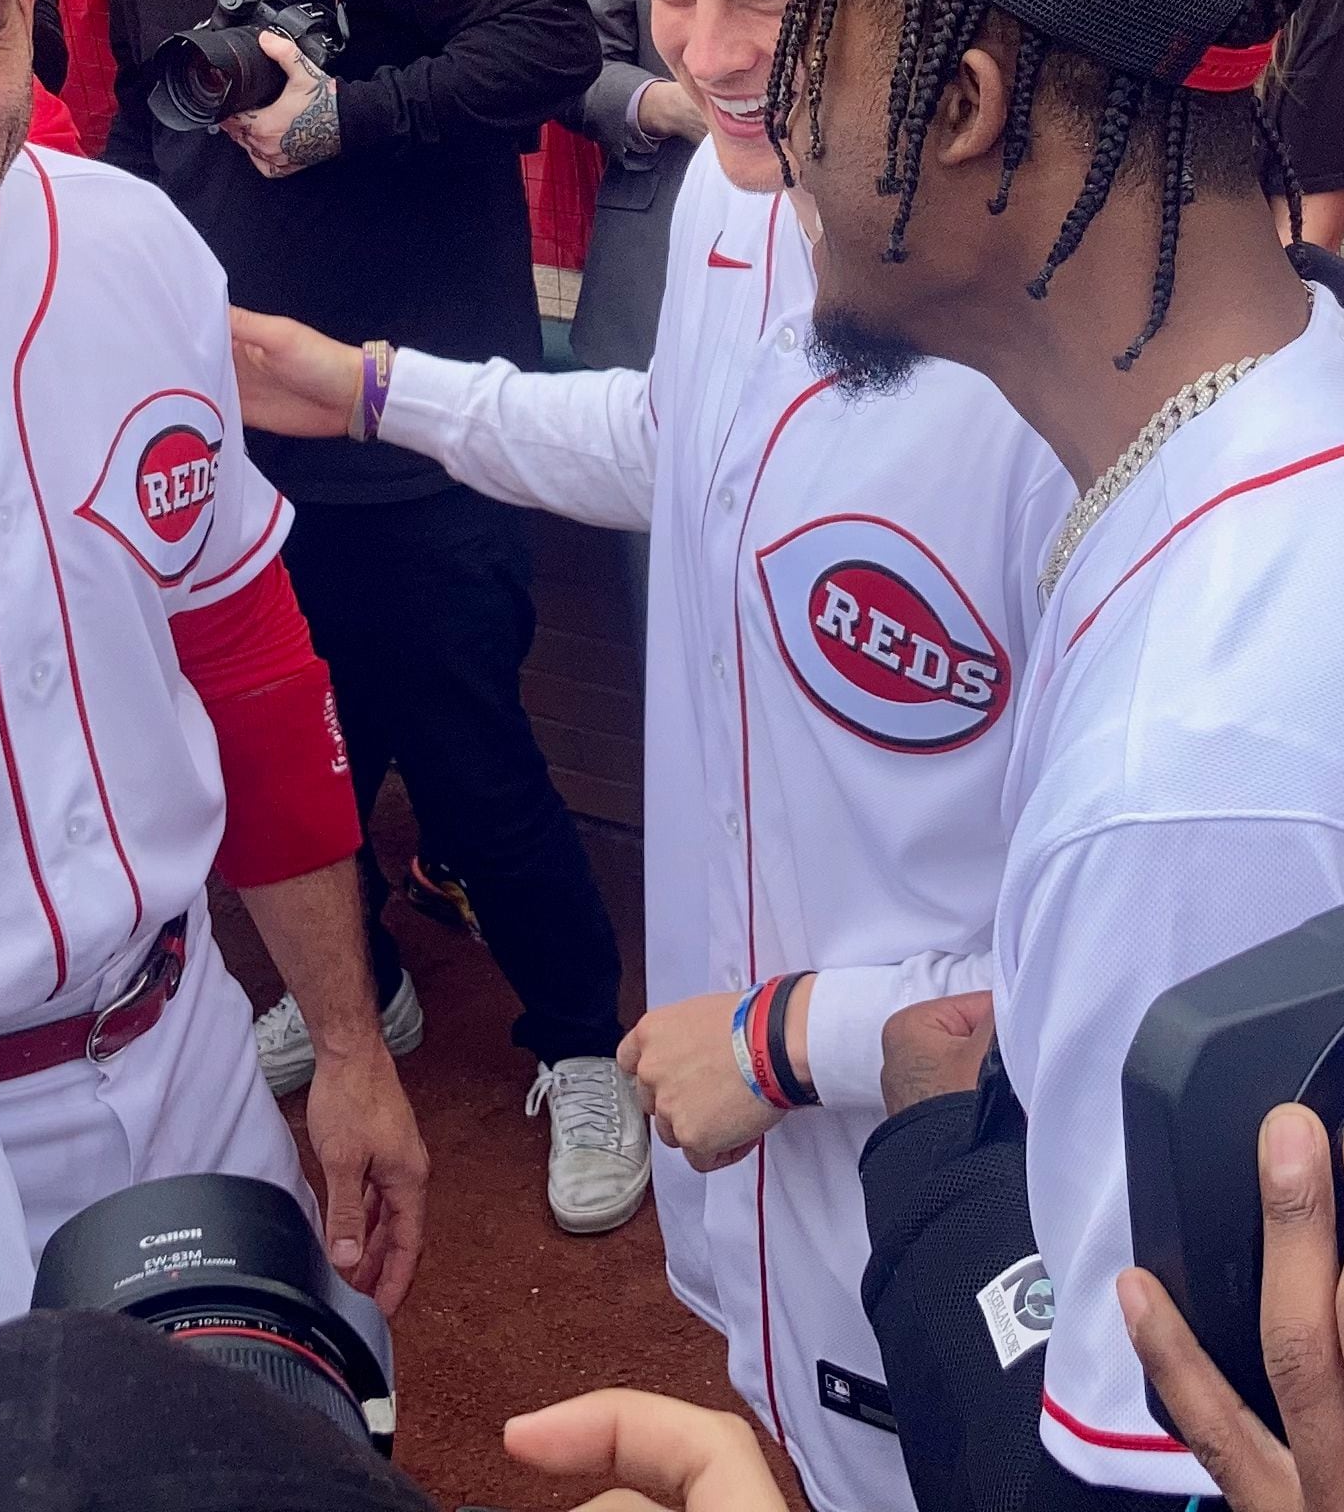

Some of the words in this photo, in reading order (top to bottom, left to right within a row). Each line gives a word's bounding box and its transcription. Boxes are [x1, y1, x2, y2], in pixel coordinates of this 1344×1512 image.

[815, 580, 998, 706] REDS
[138, 1227, 203, 1249] Canon
[113, 1271, 145, 1290] CANON
[163, 1260, 189, 1271] MADE
[190, 1258, 201, 1267] IN
[202, 1257, 237, 1267] TAIWAN
[143, 1249, 203, 1271] EW-83M
[988, 1285, 1015, 1332] KERLAN
[173, 1316, 247, 1331] 24-105mm
